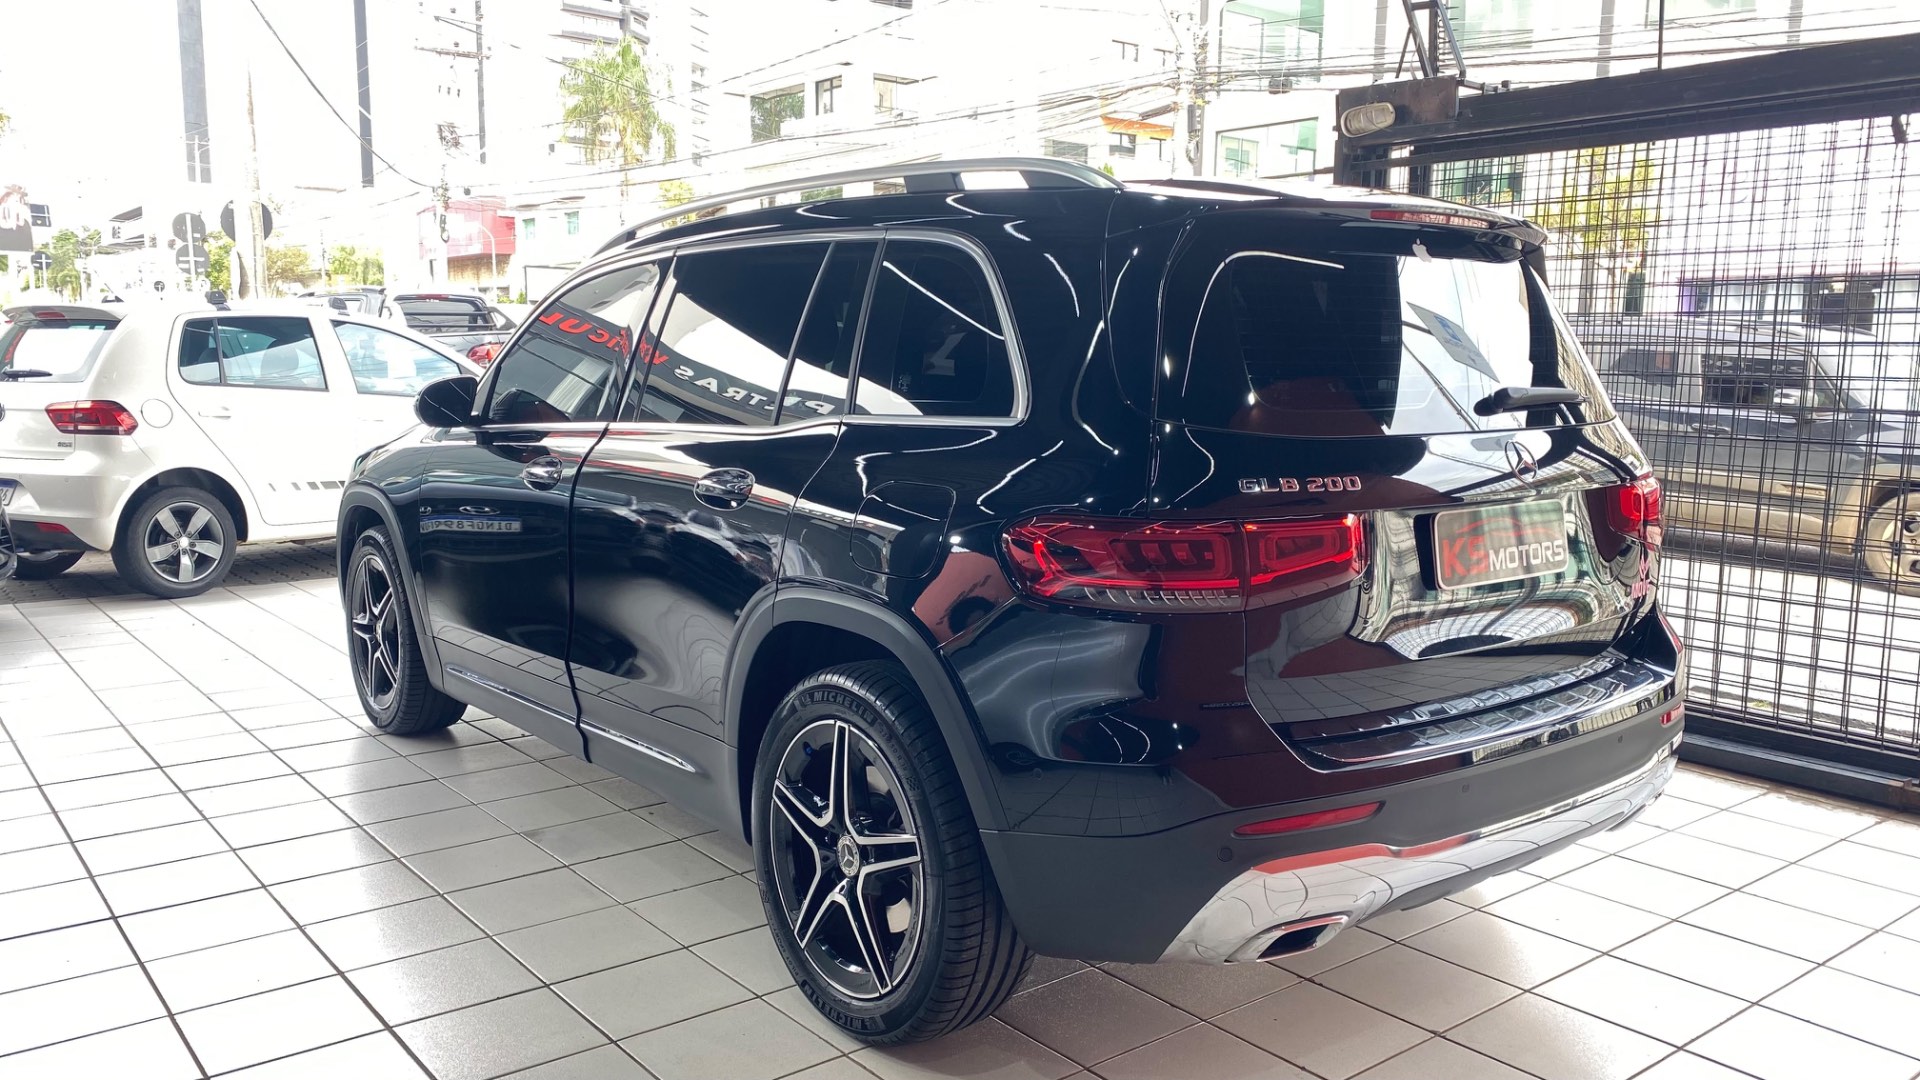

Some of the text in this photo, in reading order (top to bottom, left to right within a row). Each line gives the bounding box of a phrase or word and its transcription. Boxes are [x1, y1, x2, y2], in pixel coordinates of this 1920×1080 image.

[1238, 475, 1362, 494] GLB 200
[1442, 535, 1565, 578] KS MOTORS
[813, 690, 876, 724] MICHELIN
[803, 981, 863, 1030] MICHELIN
